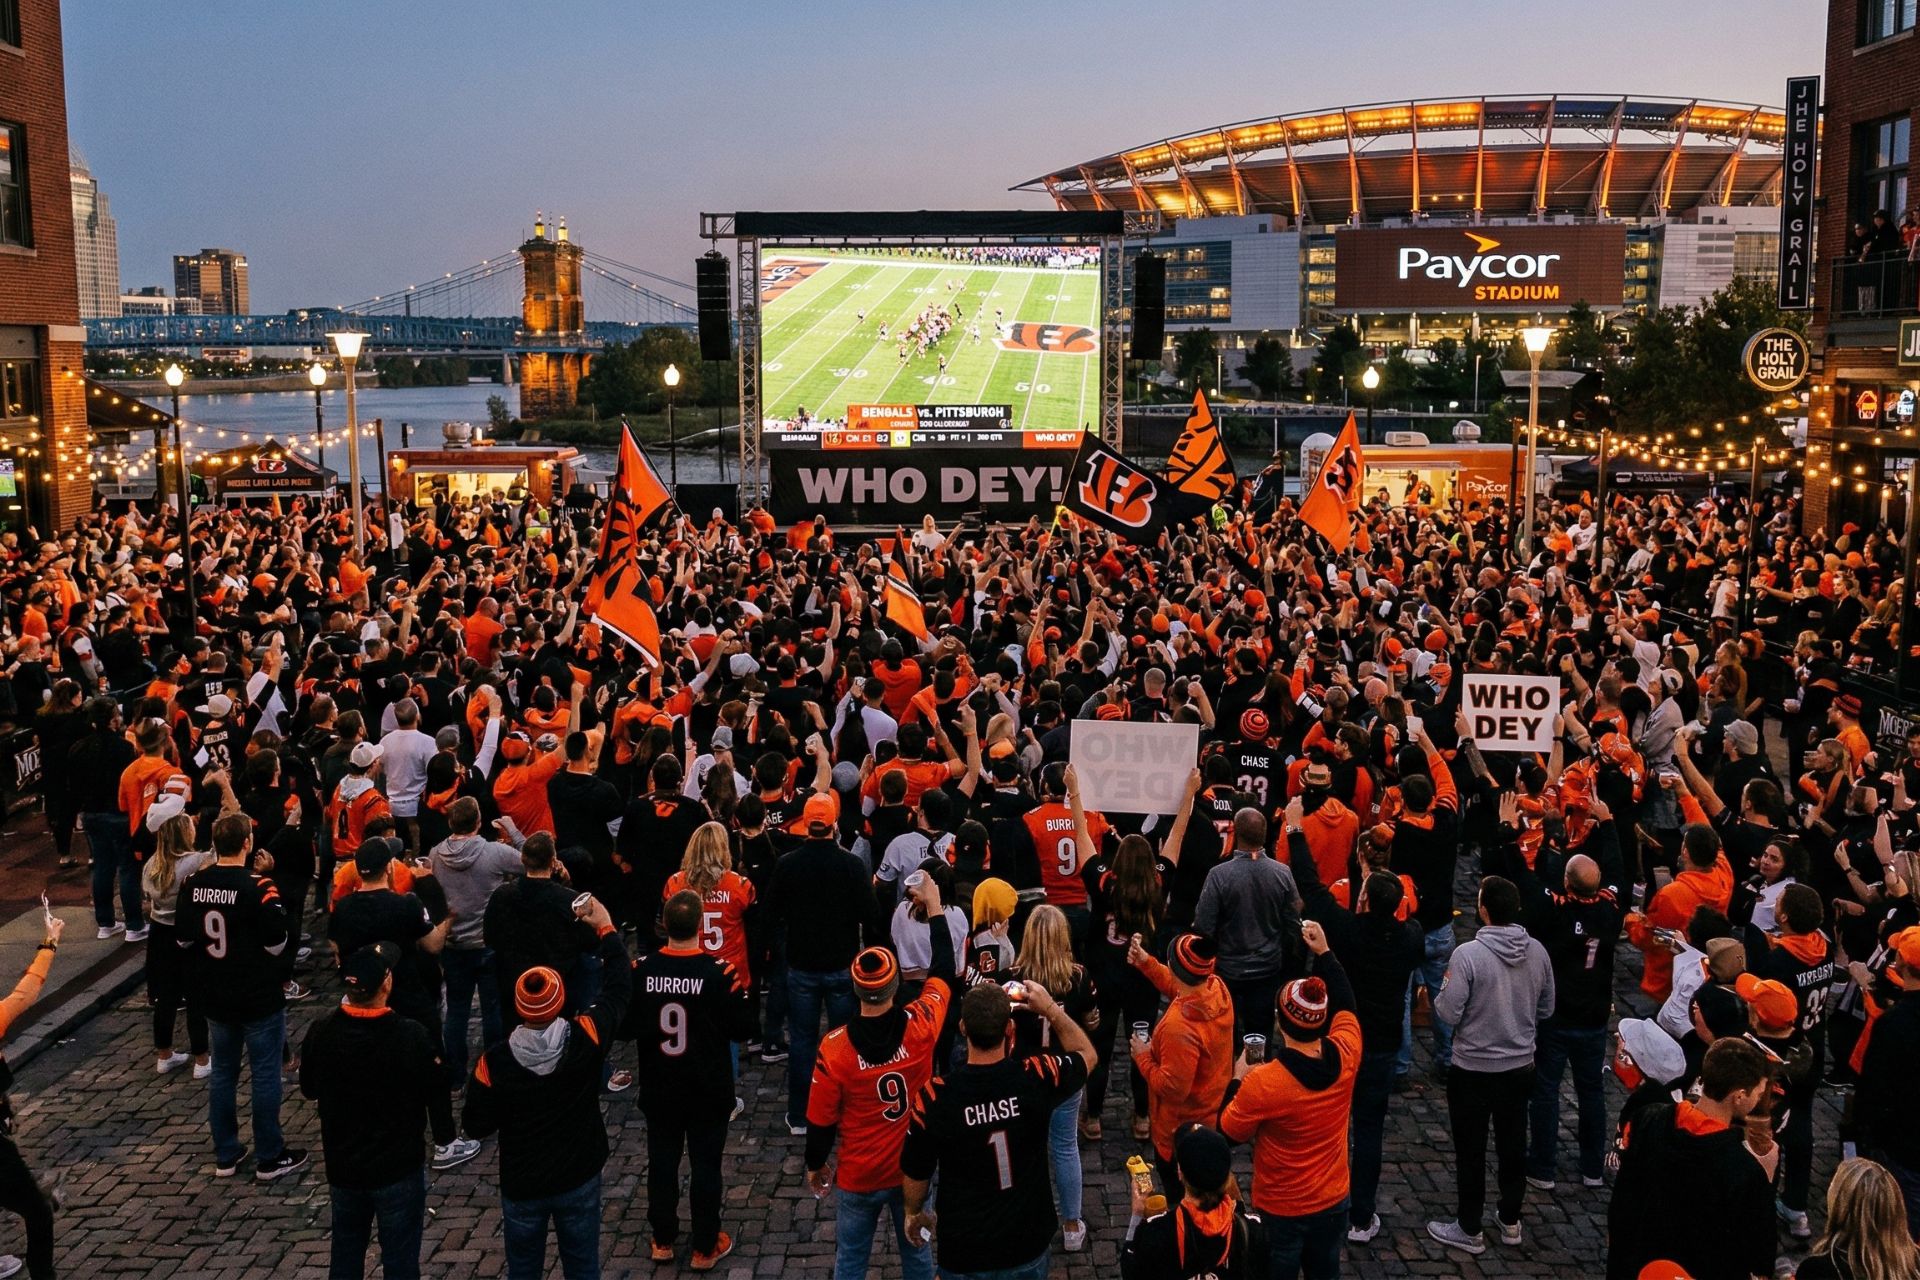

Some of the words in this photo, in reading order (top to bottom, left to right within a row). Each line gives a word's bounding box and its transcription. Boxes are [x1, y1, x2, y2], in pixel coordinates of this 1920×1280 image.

[1792, 142, 1807, 205] HOLY
[1399, 247, 1561, 288] Paycor
[1788, 219, 1803, 299] GRAIL
[1475, 285, 1560, 300] STADIUM
[1759, 352, 1798, 366] HOLY
[1764, 338, 1793, 352] THE
[1757, 366, 1799, 380] GRAIL
[861, 406, 914, 419] BENGALS
[935, 406, 1004, 419] PITTSBURGH
[797, 467, 927, 504] WHO
[940, 466, 1063, 503] DEY!
[1468, 683, 1551, 711] WHO
[1475, 714, 1543, 742] DEY
[1241, 755, 1270, 769] CHASE
[1046, 818, 1075, 832] BURR
[1057, 837, 1076, 876] 9
[193, 887, 238, 905] BURROW
[204, 910, 227, 959] 9
[702, 911, 724, 951] 5
[646, 976, 704, 995] BURROW
[660, 1002, 686, 1056] 9
[876, 1071, 909, 1122] 9
[964, 1097, 1021, 1126] CHASE
[987, 1131, 1012, 1190] 1
